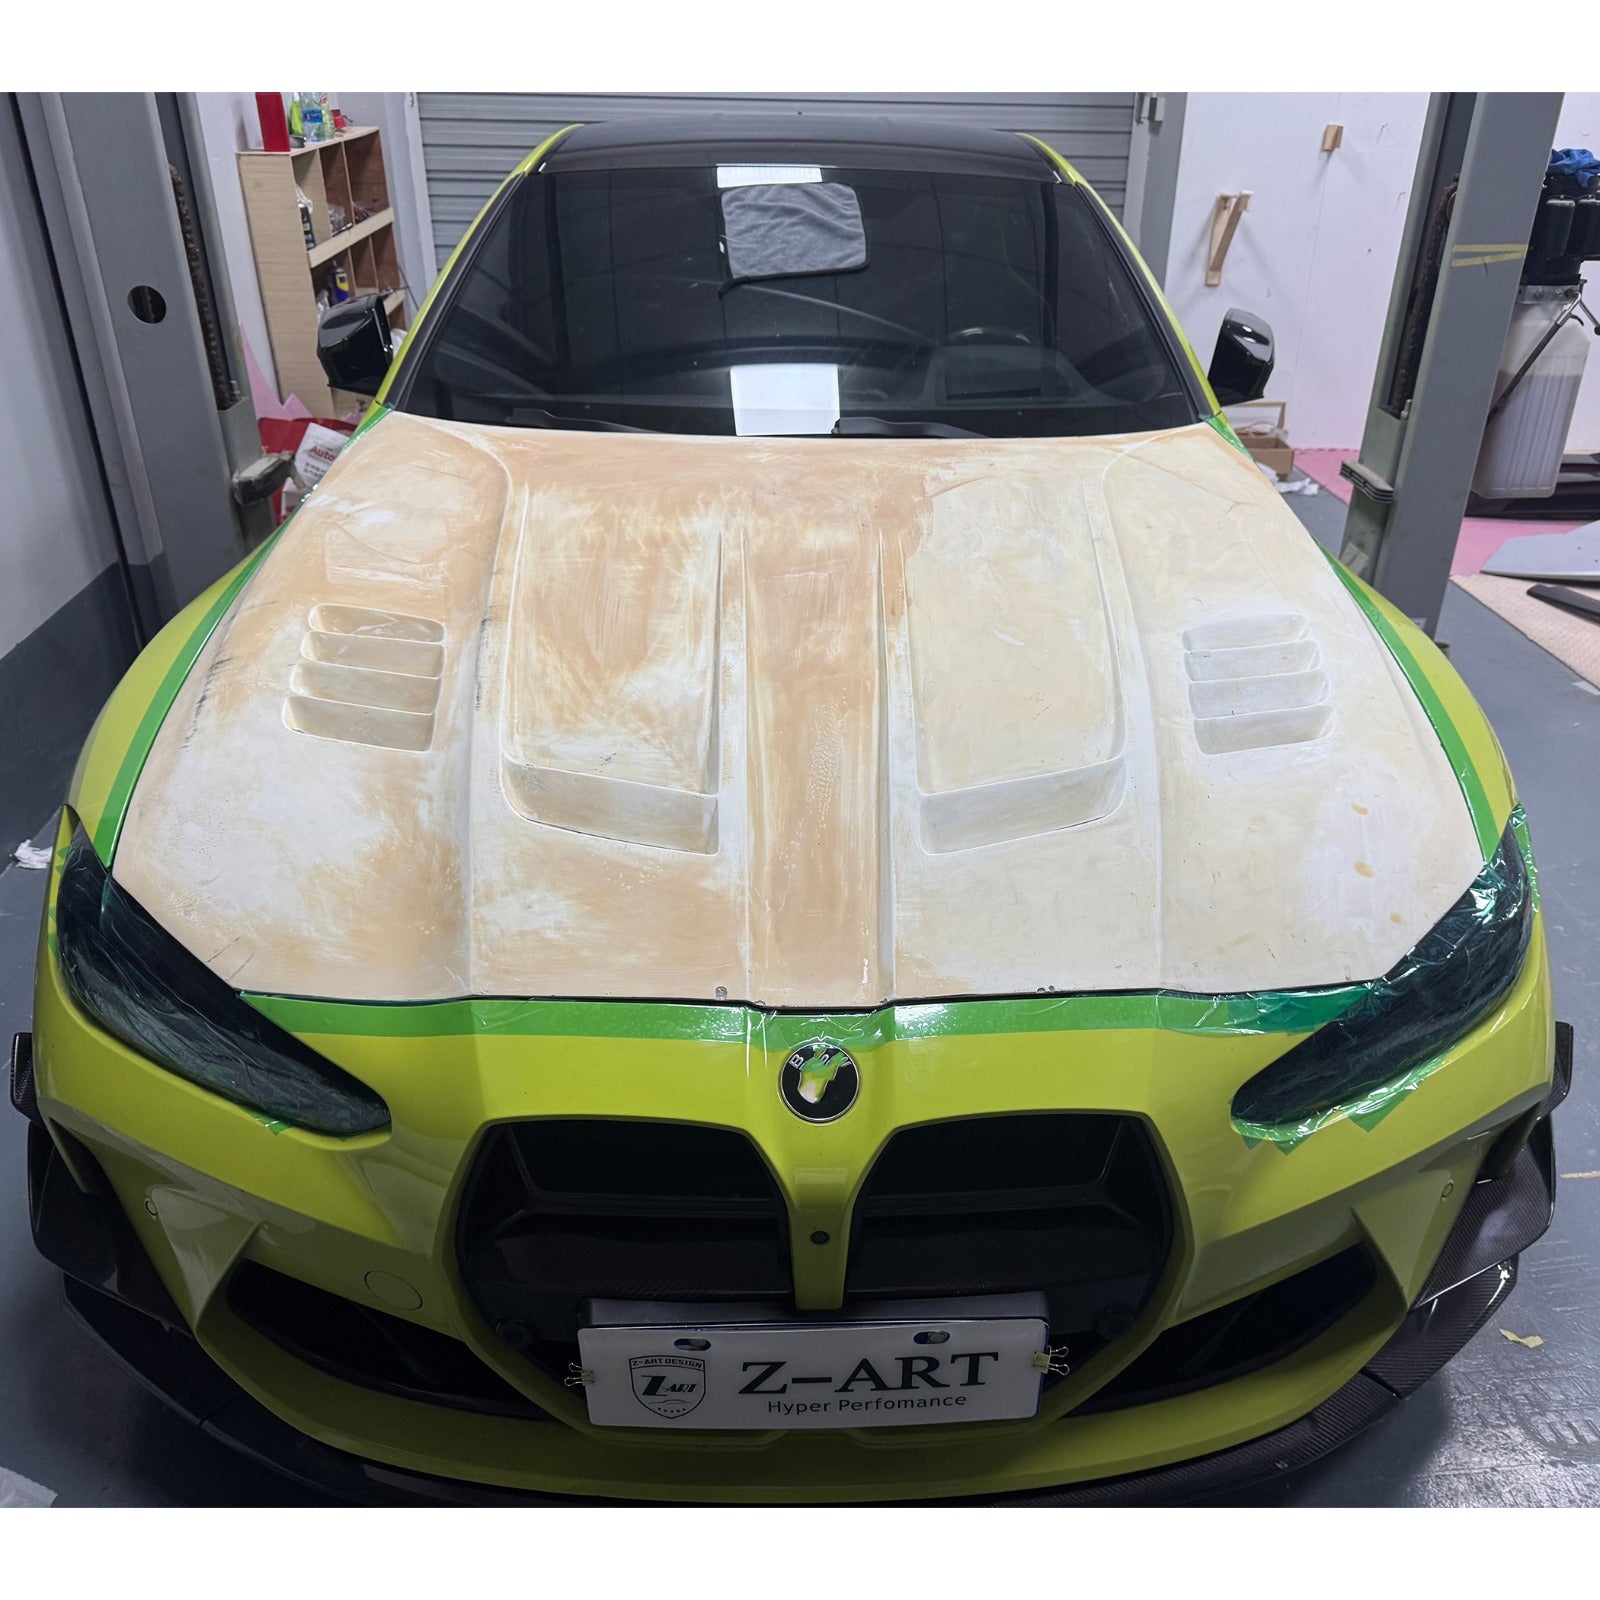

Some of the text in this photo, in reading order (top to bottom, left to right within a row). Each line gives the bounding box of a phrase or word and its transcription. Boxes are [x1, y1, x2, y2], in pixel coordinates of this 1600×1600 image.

[632, 1358, 703, 1368] Z-ART DESIGN
[738, 1352, 999, 1395] Z-ART
[768, 1395, 967, 1416] Hyper Perfomance
